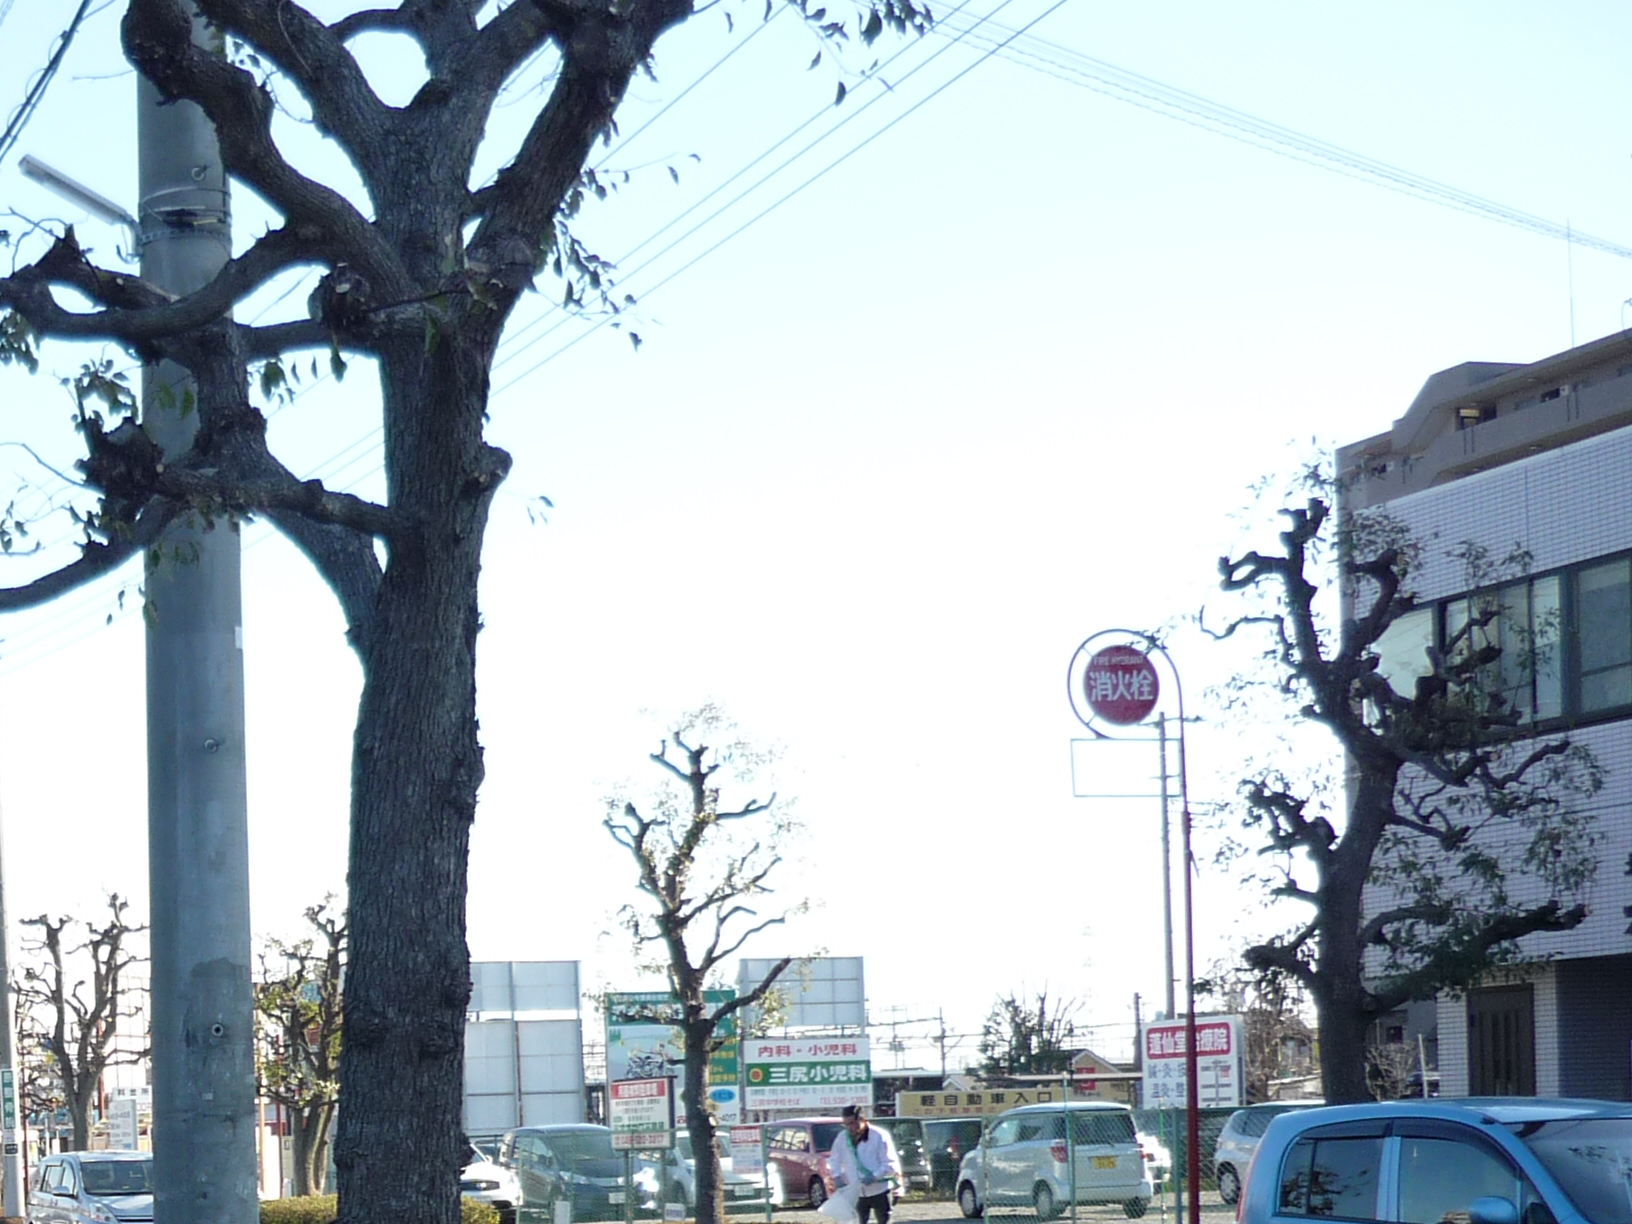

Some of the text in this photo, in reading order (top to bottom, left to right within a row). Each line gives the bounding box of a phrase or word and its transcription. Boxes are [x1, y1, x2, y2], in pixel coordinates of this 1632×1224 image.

[1089, 670, 1153, 701] 消火栓
[758, 1043, 857, 1058] 内科・小児科
[769, 1064, 867, 1083] 三尻小児科
[920, 1091, 1052, 1107] 軽自動車入口
